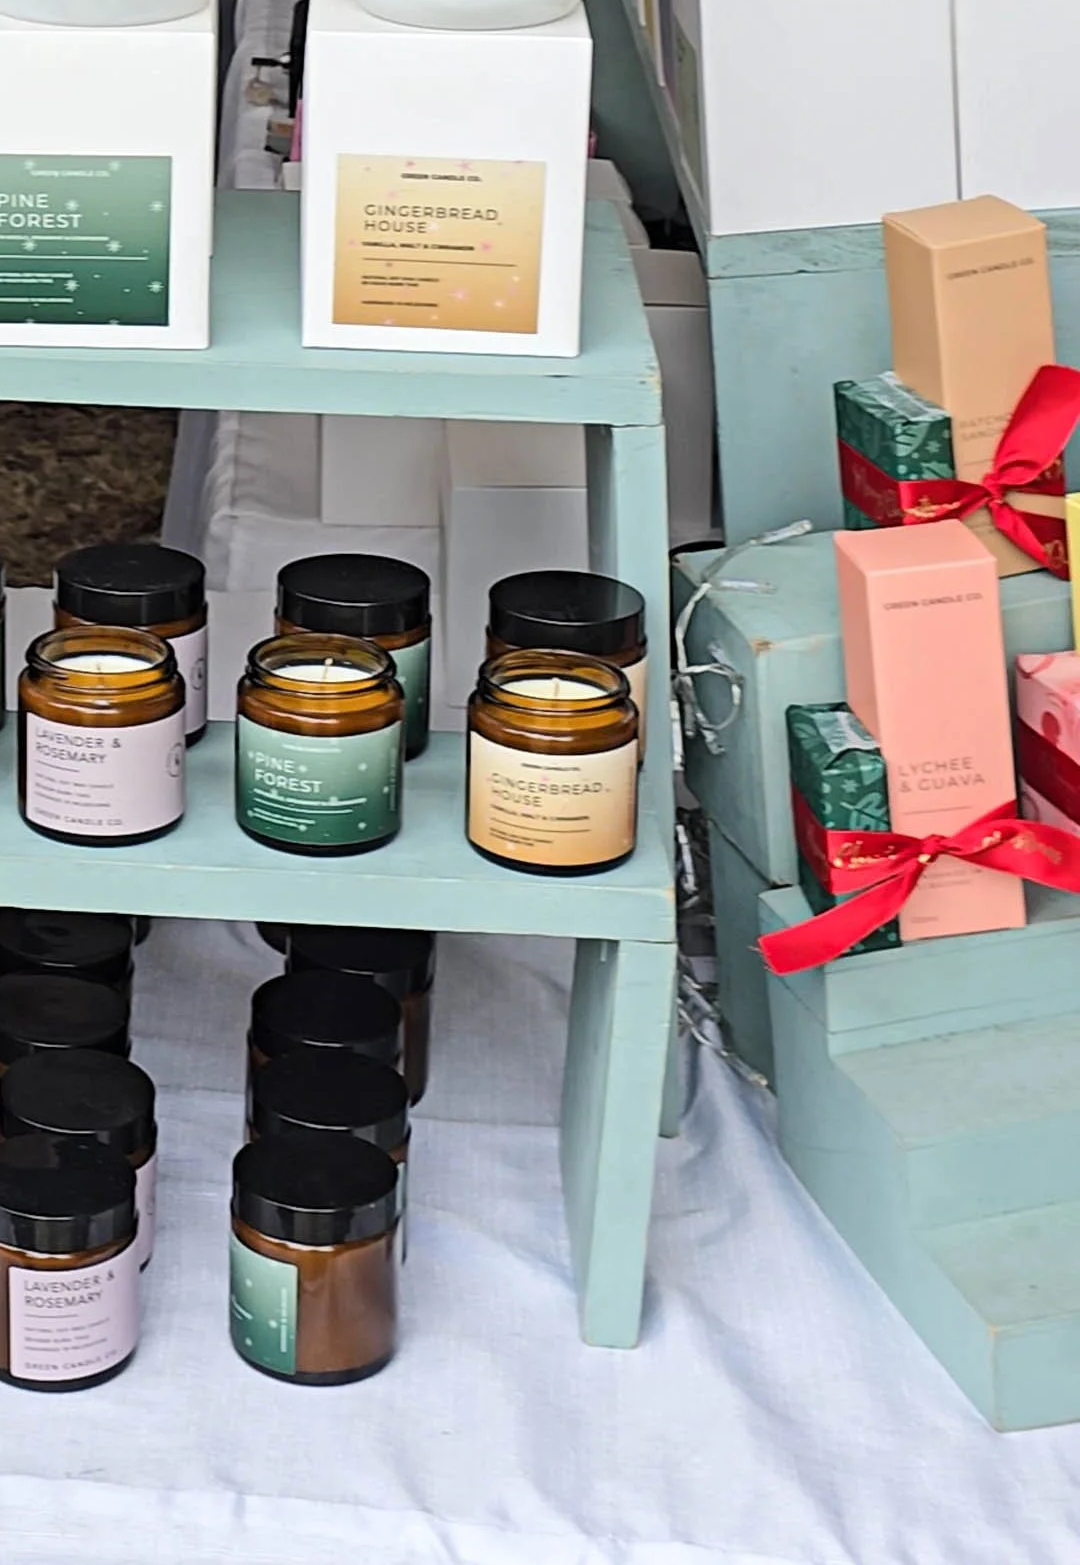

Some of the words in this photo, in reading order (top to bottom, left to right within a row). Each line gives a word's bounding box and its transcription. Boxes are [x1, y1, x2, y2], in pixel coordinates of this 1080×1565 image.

[364, 203, 499, 221] GINGERBREAD
[364, 219, 428, 234] HOUSE
[35, 726, 105, 749] LAVENDER
[111, 737, 122, 749] &
[35, 741, 107, 764] ROSEMARY
[254, 750, 296, 774] PINE
[897, 756, 973, 778] LYCHEE
[254, 768, 324, 793] FOREST
[491, 772, 603, 796] GINGERBREAD
[899, 780, 913, 793] &
[918, 773, 986, 791] GUAVA
[491, 789, 543, 808] HOUSE
[23, 1275, 102, 1293] LAVENDER
[24, 1289, 103, 1309] ROSEMARY
